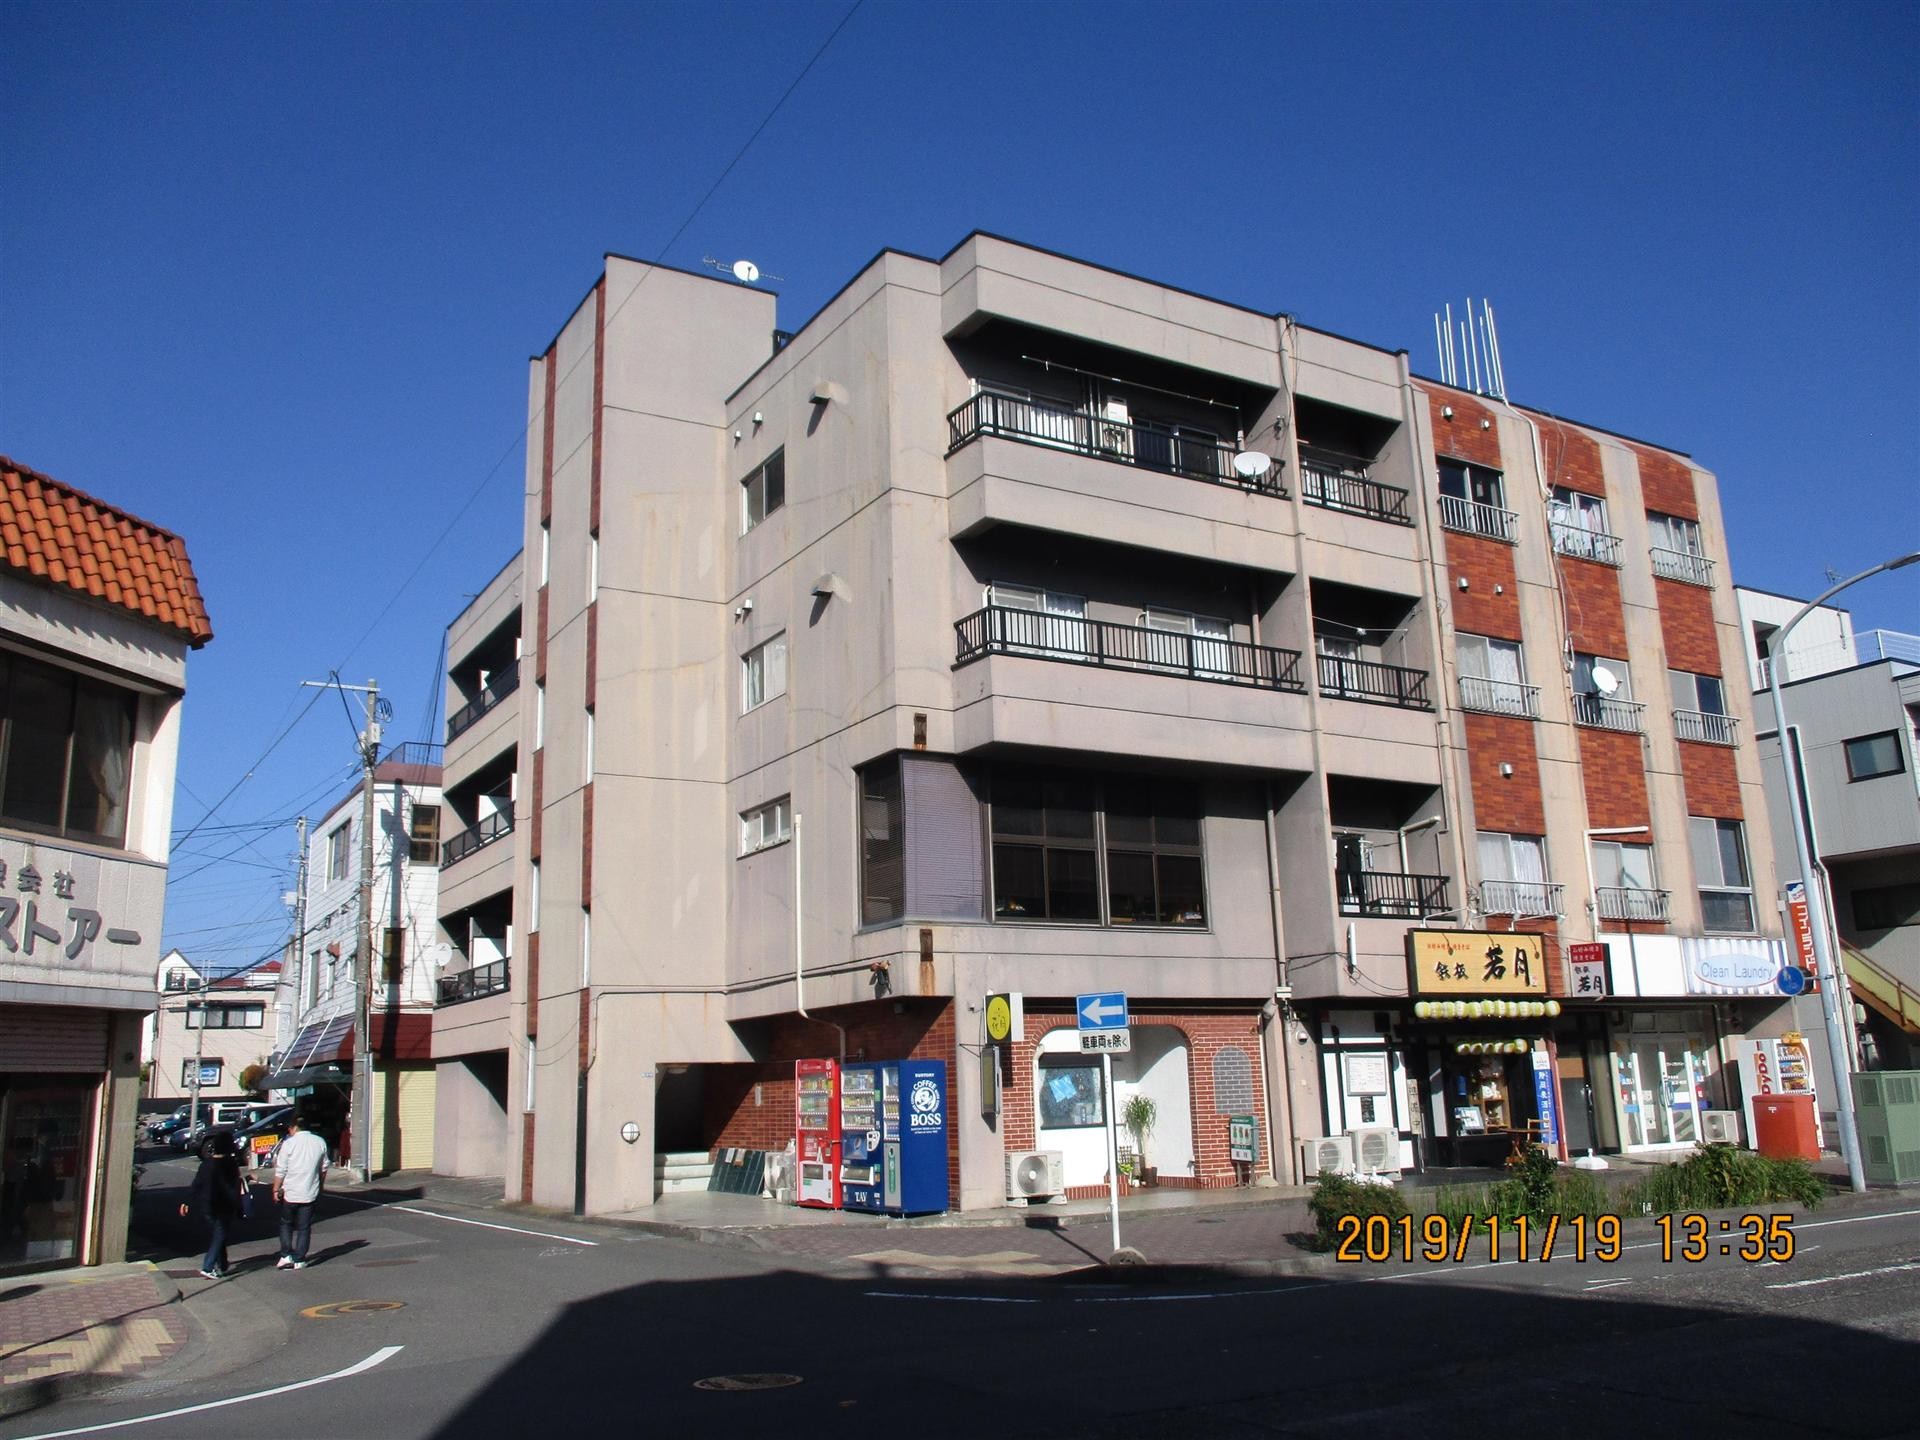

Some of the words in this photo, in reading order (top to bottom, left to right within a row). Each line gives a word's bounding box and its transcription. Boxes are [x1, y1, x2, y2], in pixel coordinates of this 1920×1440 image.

[1482, 943, 1531, 987] 若月
[1701, 962, 1729, 978] Clean
[1734, 963, 1773, 981] Laundry
[1578, 974, 1603, 994] 若月
[1082, 1034, 1127, 1049] 軽車両を除く
[1758, 1053, 1773, 1095] DyDo
[913, 1080, 937, 1091] COFFEE
[910, 1113, 942, 1126] BOSS
